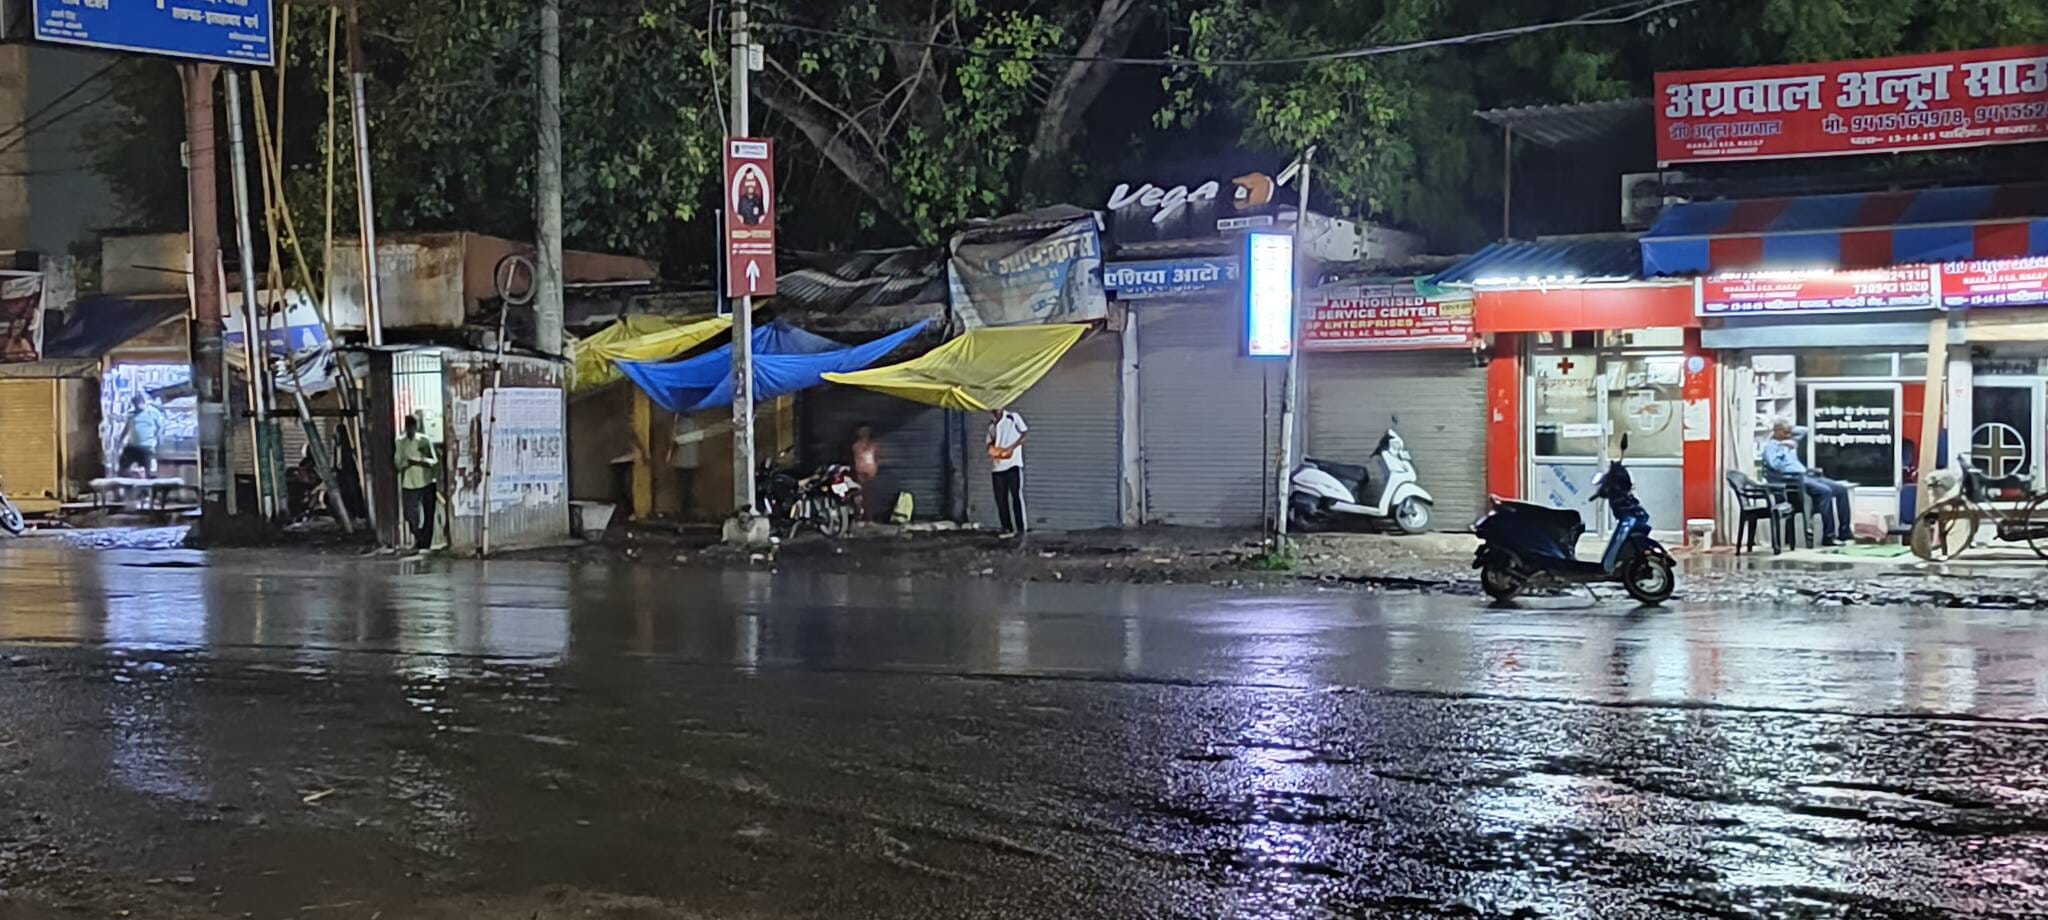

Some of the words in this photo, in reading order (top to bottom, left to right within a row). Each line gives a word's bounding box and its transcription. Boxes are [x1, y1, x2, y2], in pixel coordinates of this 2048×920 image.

[1665, 75, 1826, 118] अग्रवाल
[1836, 64, 1954, 111] अल्ट्रा
[1975, 101, 2048, 123] 941552
[1172, 262, 1221, 283] आटो
[1330, 296, 1425, 309] AUTHORISED
[1317, 308, 1377, 320] SERVICE
[1380, 306, 1438, 318] CENTER
[1325, 318, 1414, 330] ENTERPRISES
